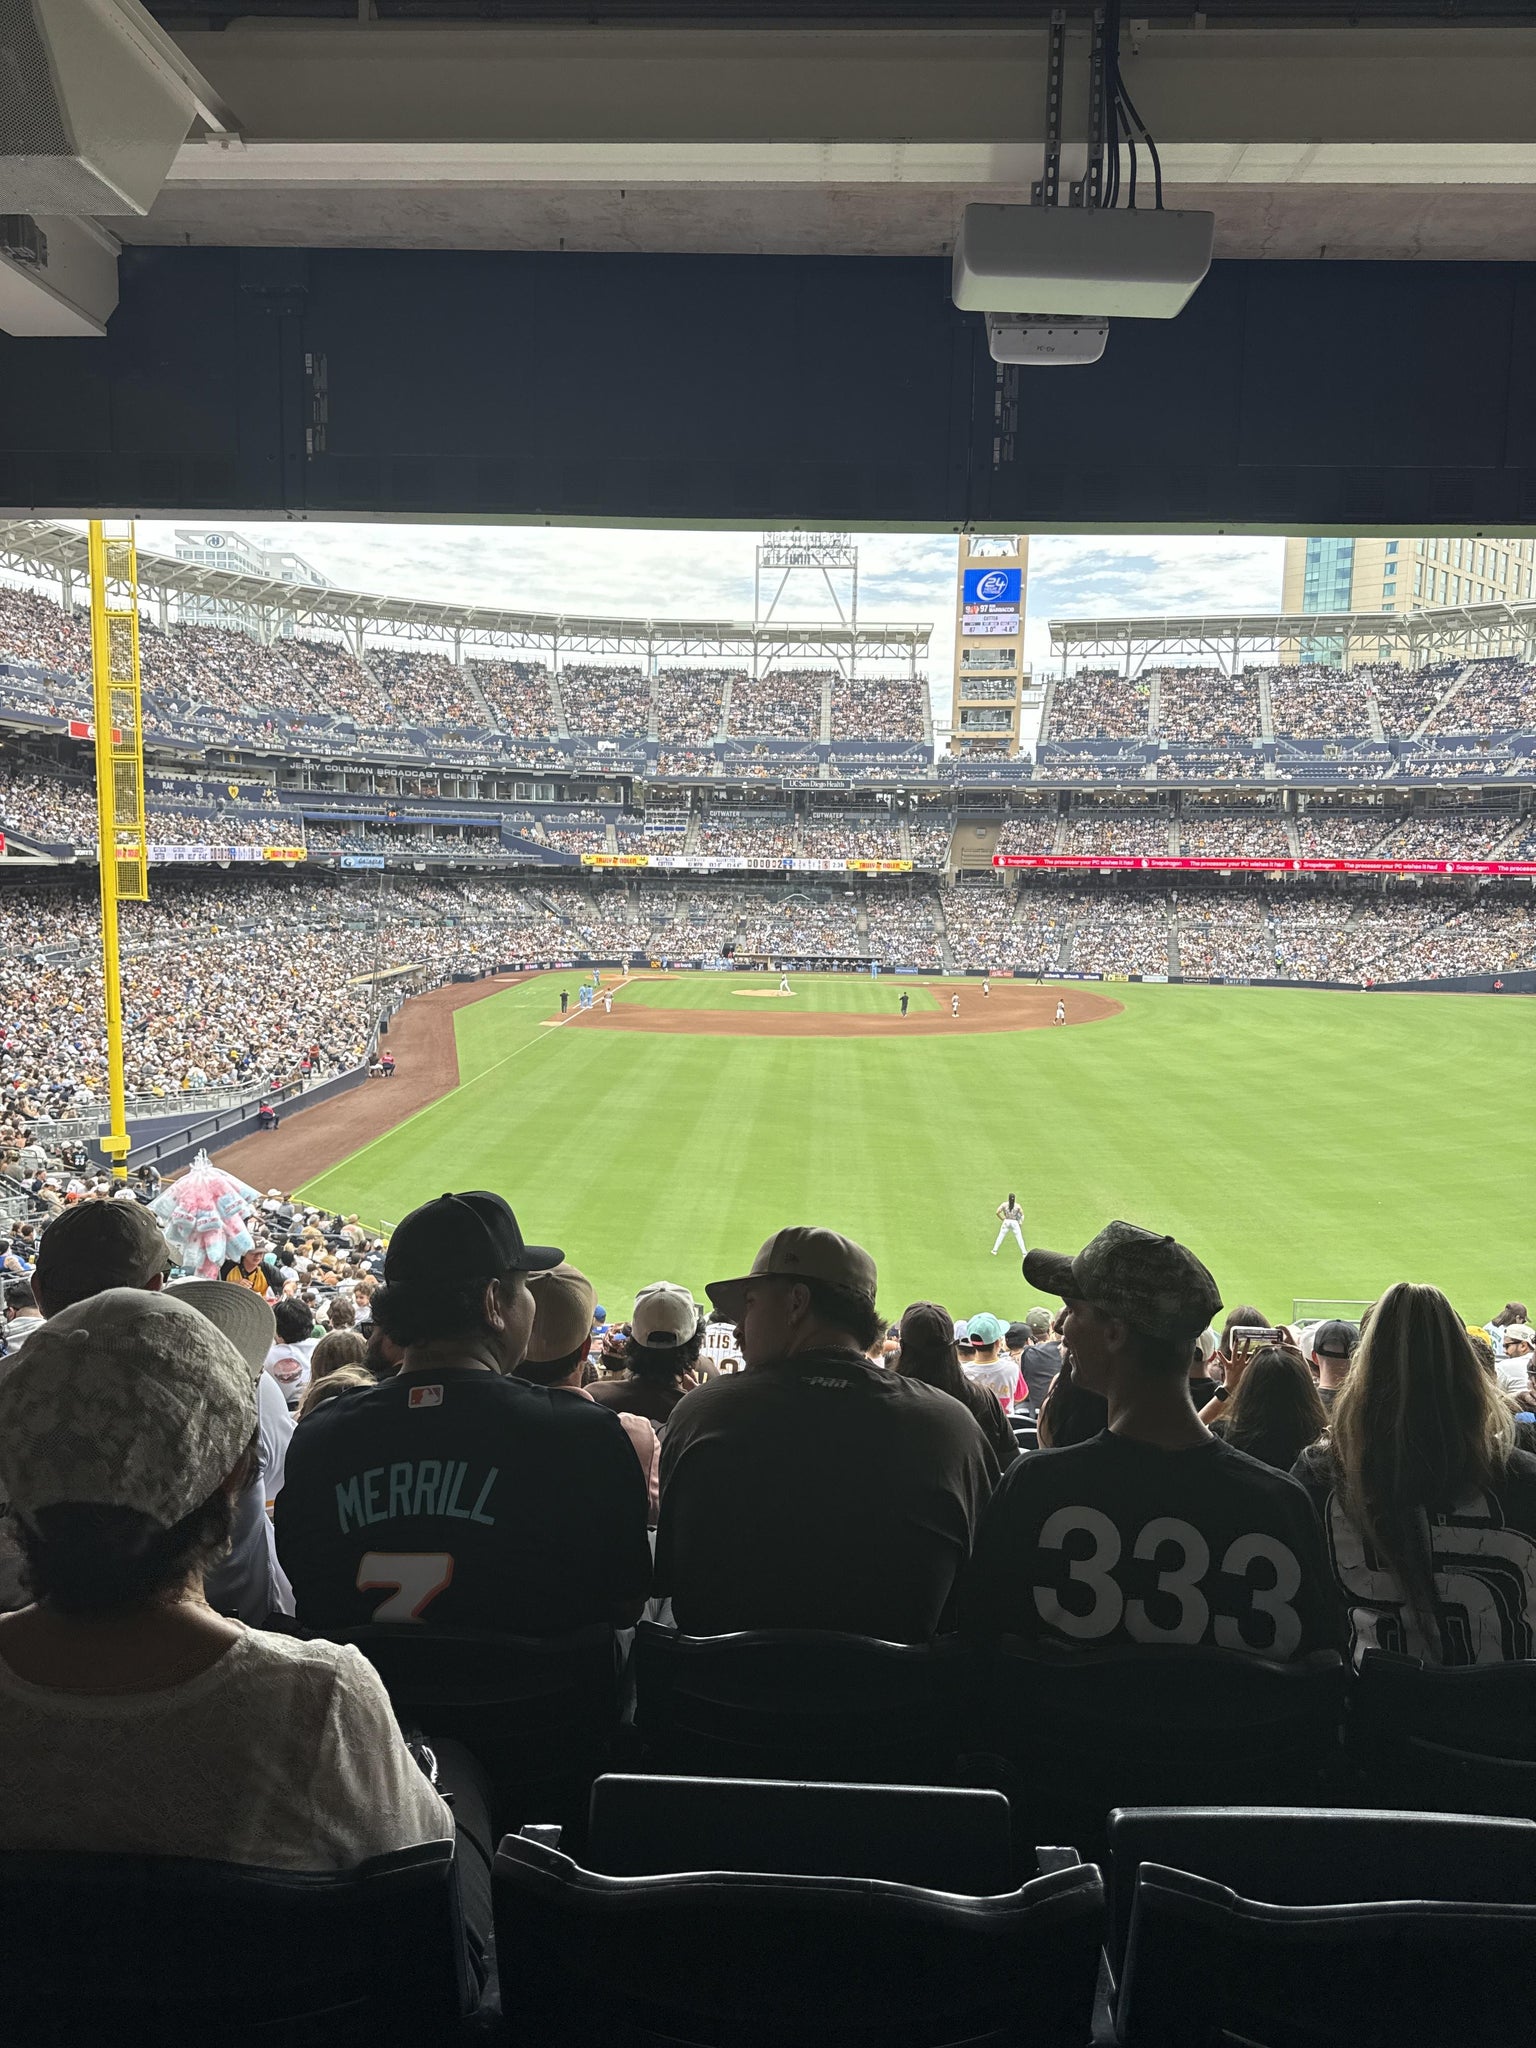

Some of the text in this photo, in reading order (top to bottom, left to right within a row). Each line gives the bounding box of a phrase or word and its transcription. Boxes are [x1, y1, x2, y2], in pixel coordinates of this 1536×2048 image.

[984, 578, 1005, 590] 24
[290, 762, 484, 781] JERRY COLEMAN BROADCAST CENTER
[336, 1460, 499, 1535] MERRILL
[356, 1551, 455, 1625] 7
[1032, 1505, 1301, 1660] 333
